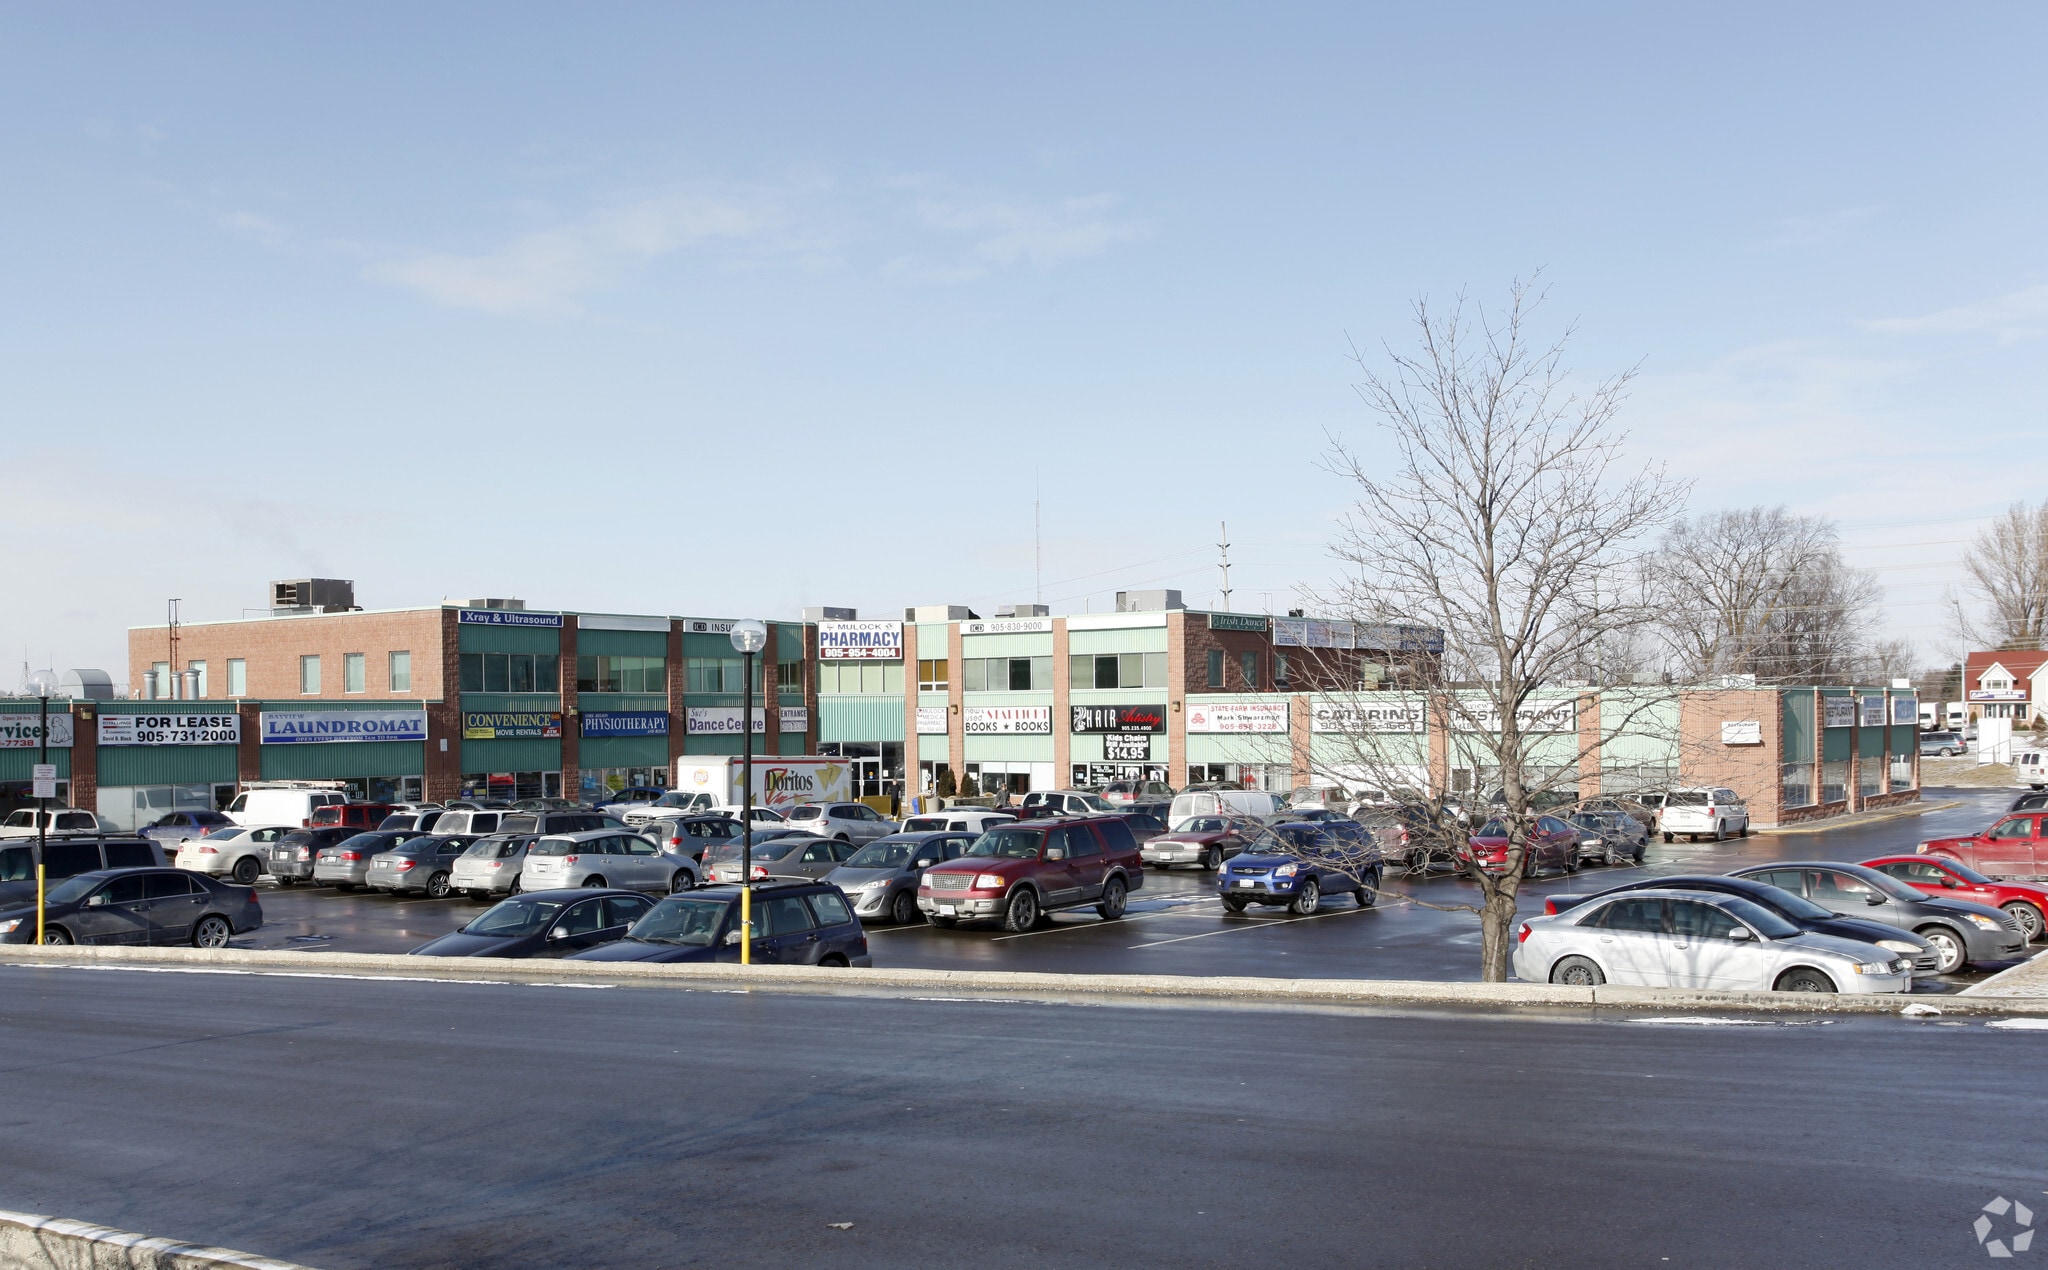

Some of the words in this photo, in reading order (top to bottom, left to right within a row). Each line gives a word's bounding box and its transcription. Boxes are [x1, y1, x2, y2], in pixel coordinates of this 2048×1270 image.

[466, 612, 489, 623] Xray
[493, 613, 501, 622] &
[504, 614, 557, 625] Ultrasound
[1220, 616, 1238, 625] Irish
[1240, 617, 1264, 626] Dance
[711, 623, 734, 632] INSU
[820, 632, 899, 646] PHARMACY
[825, 648, 896, 657] 905-954-4004
[690, 709, 708, 717] Sue's
[781, 709, 807, 718] ENTRANCE
[1086, 709, 1116, 728] HAIR
[1116, 706, 1161, 727] Artistry
[135, 717, 171, 728] FOR
[177, 717, 232, 728] LEASE
[468, 713, 551, 727] CONVENIENCE
[585, 717, 666, 730] PHYSIOTHERAPY
[689, 718, 724, 730] Dance
[727, 717, 763, 730] Cere
[268, 719, 422, 735] LAUNDROMAT
[516, 728, 541, 736] RENTALS
[965, 722, 998, 731] BOOKS
[1015, 722, 1049, 731] BOOKS
[1107, 747, 1144, 760] $14.95
[766, 770, 813, 791] Doritos
[343, 783, 359, 791] ITH
